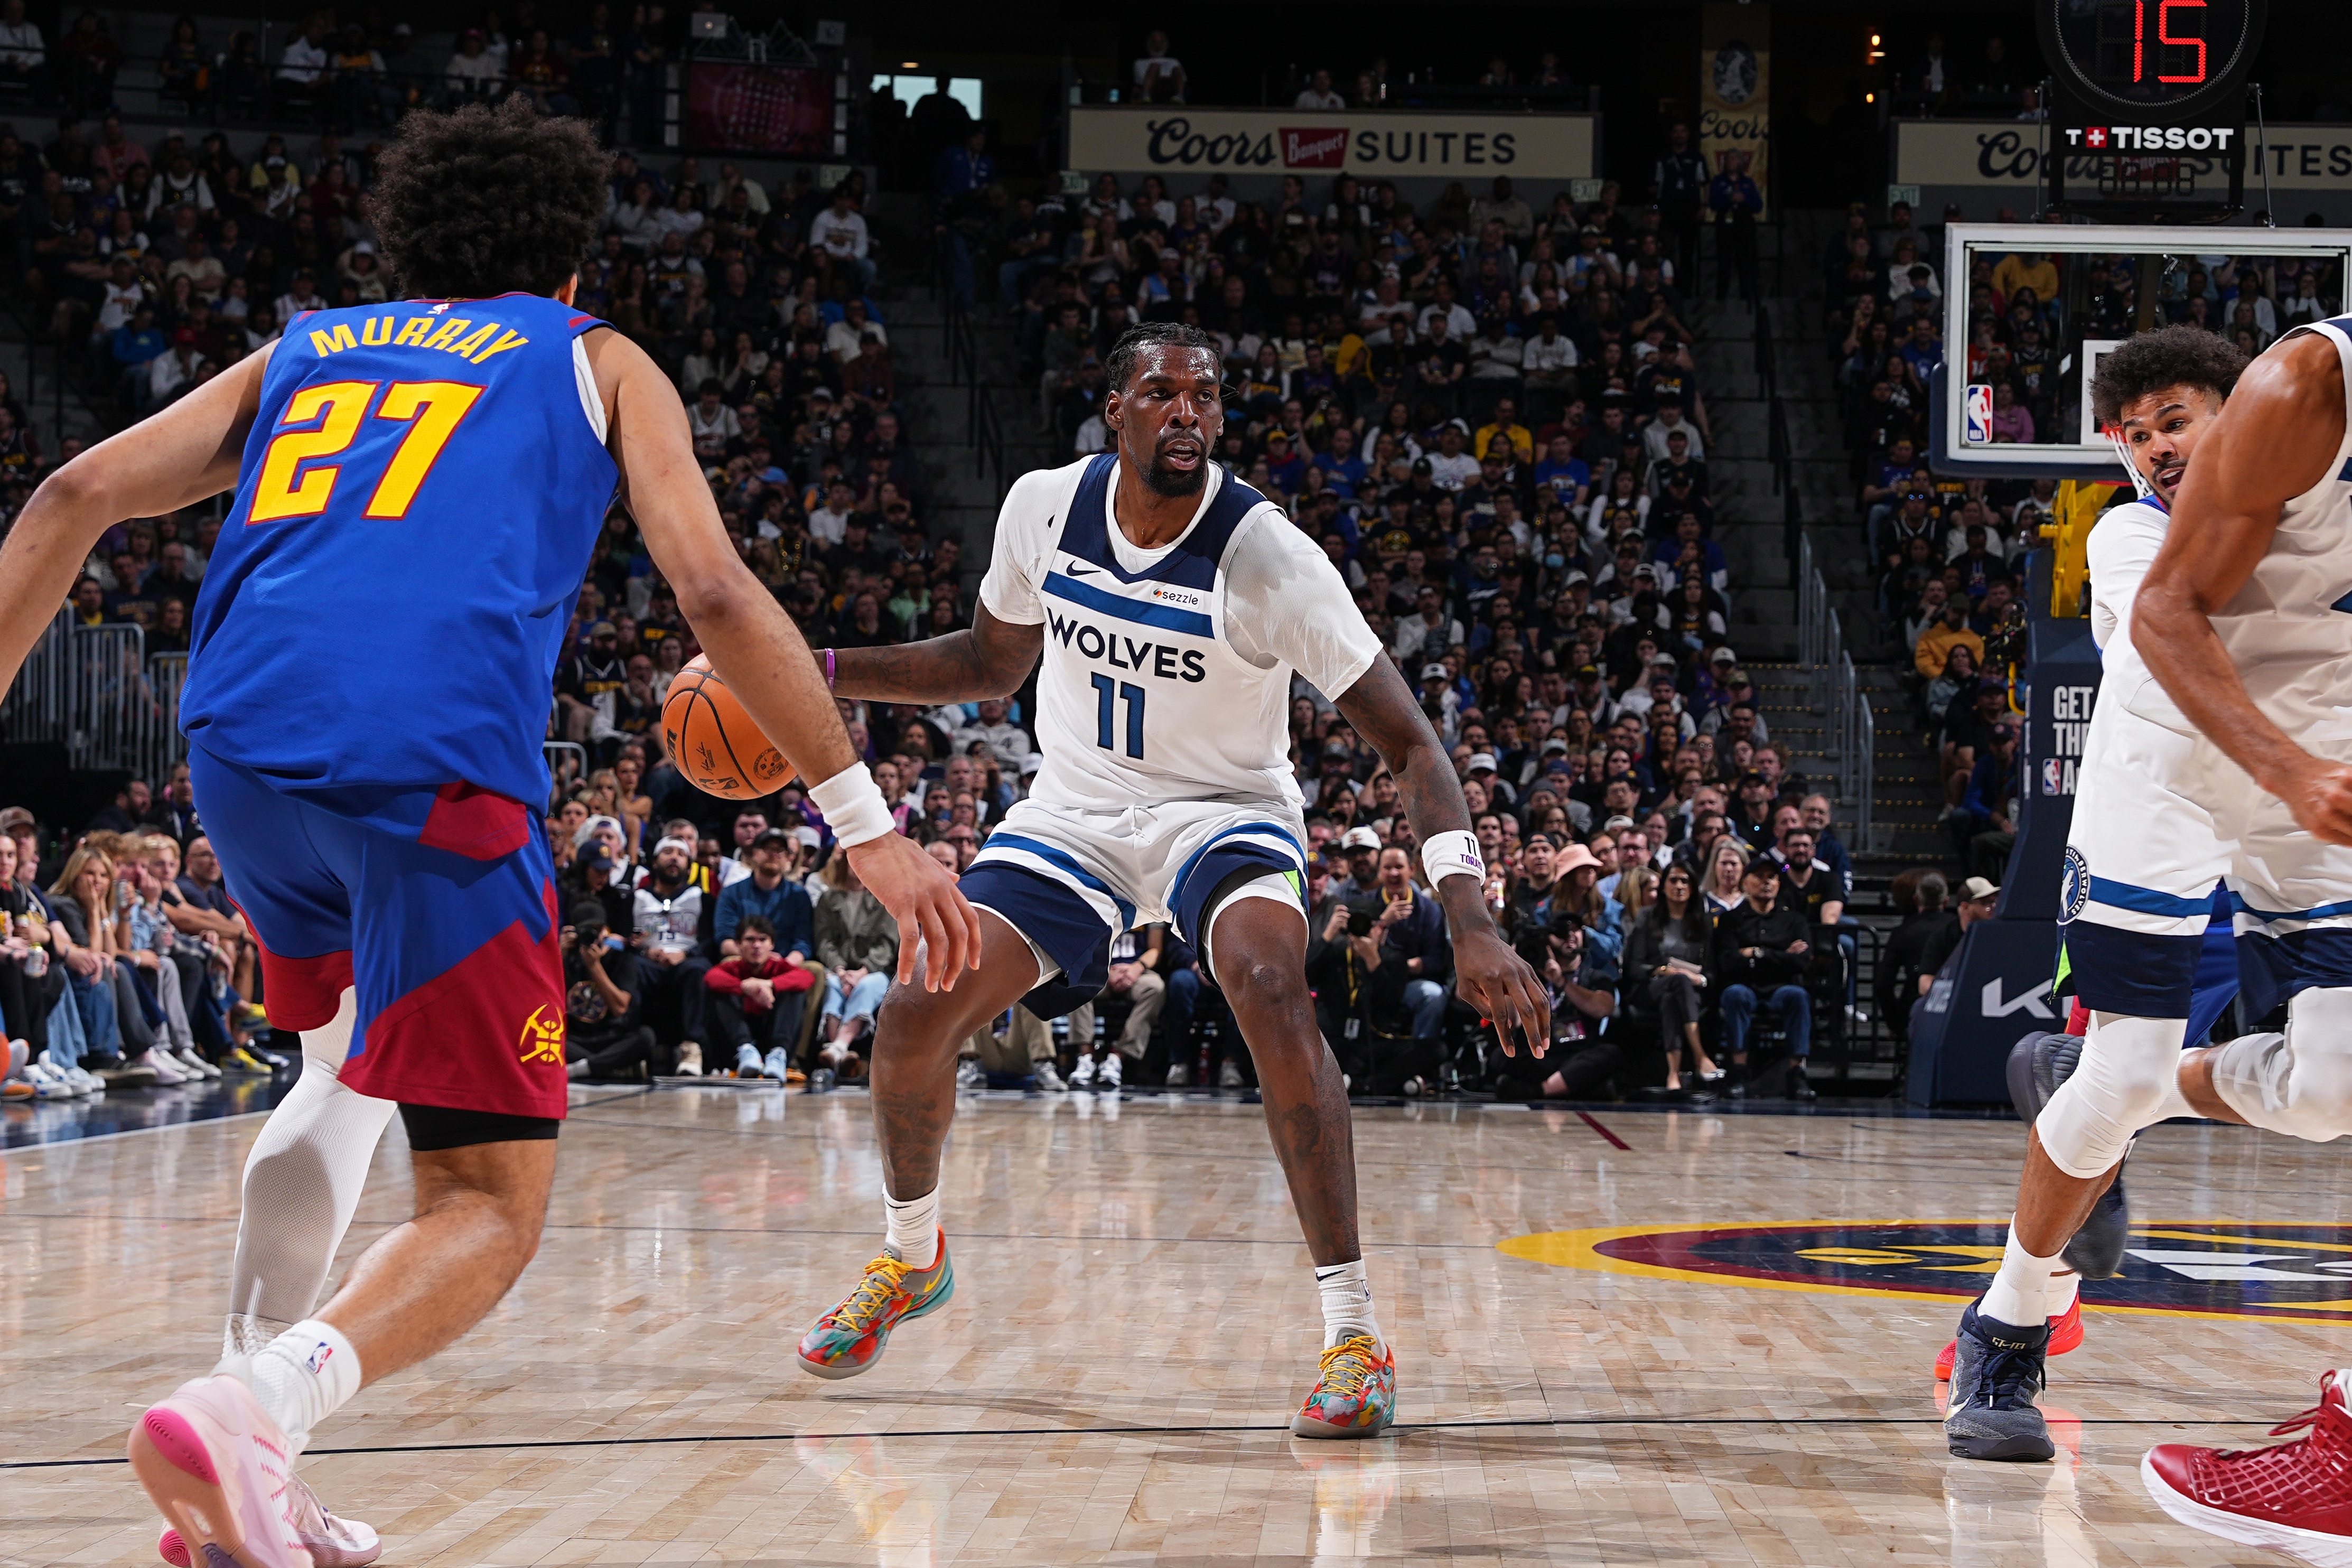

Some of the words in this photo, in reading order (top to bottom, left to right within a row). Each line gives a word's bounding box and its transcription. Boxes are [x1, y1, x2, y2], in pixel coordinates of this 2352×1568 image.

[2133, 0, 2207, 83] 15
[1147, 118, 1276, 165] Coors
[1356, 132, 1516, 164] SUITES
[2111, 127, 2234, 151] TISSOT
[309, 316, 529, 365] MURRAY
[246, 380, 488, 526] 27
[1162, 591, 1198, 605] sezzle
[1047, 606, 1206, 683] WOLVES
[1090, 671, 1145, 760] 11
[2053, 685, 2094, 721] GET
[1464, 836, 1478, 857] 11
[2069, 848, 2088, 916] TIMBERWOLVES
